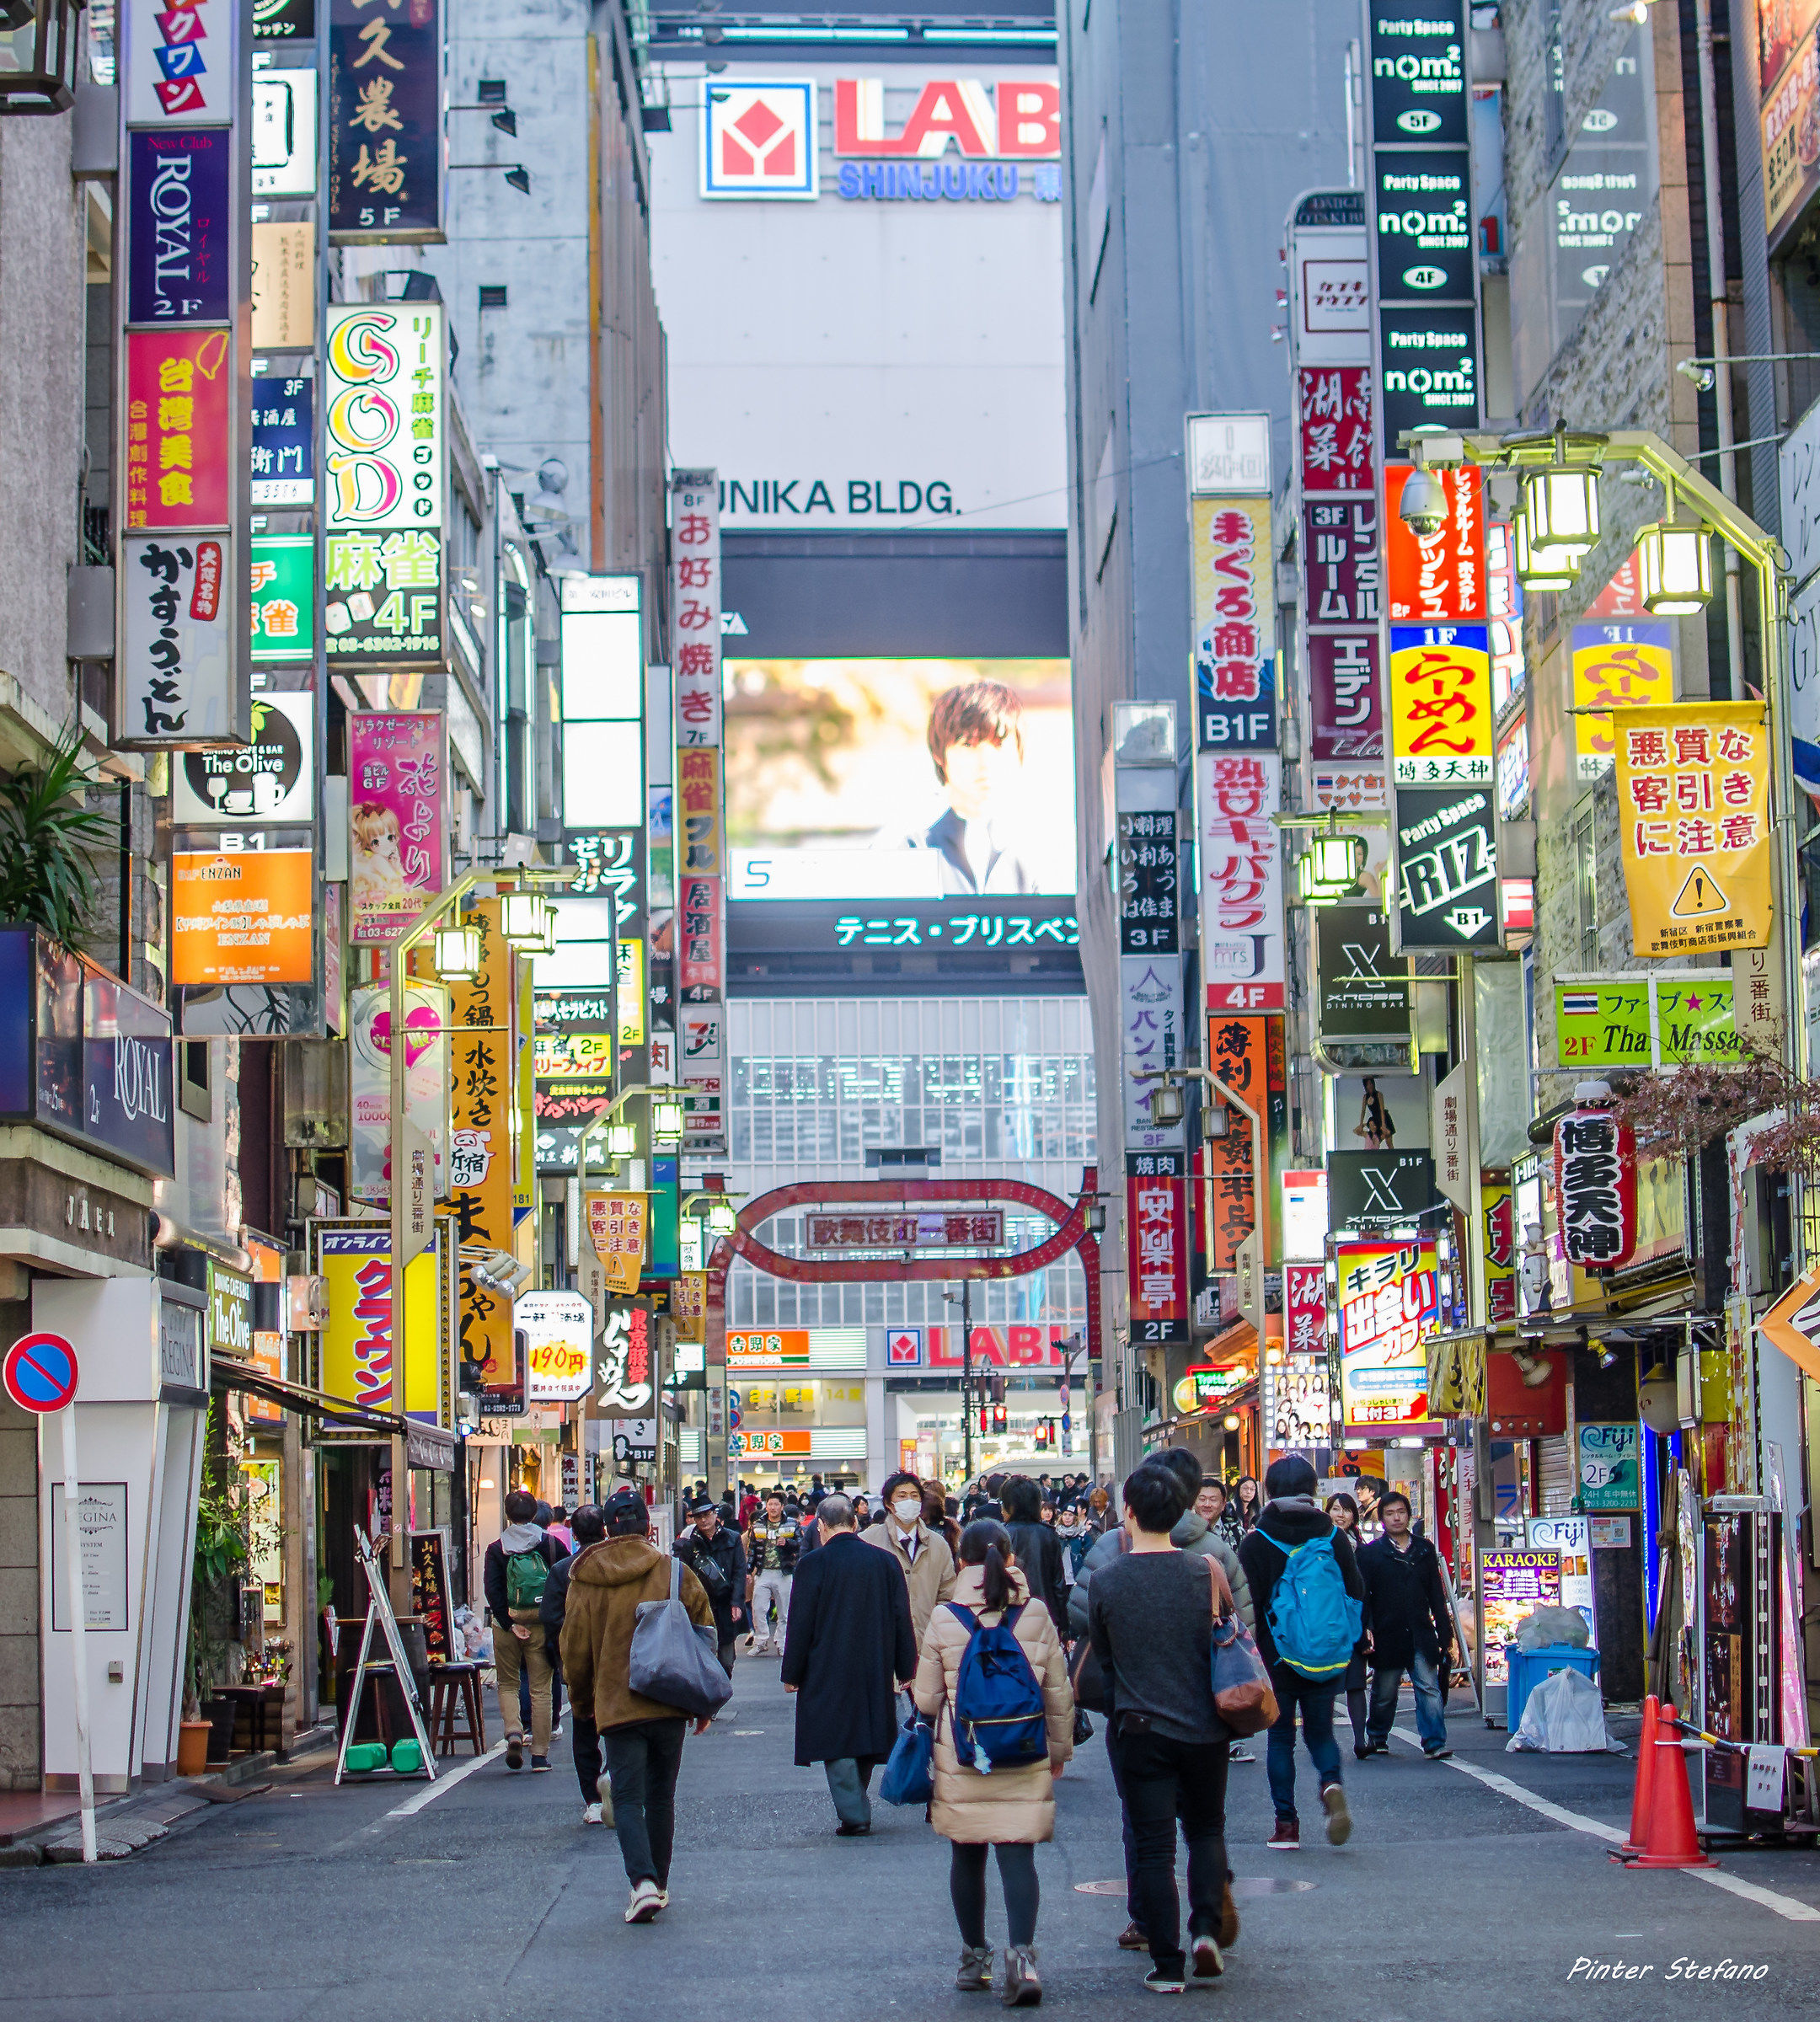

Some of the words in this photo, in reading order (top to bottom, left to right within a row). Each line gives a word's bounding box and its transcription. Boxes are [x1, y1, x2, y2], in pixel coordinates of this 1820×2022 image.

[1378, 19, 1414, 37] Party
[1415, 19, 1455, 37] Space
[167, 0, 195, 111] クワン
[349, 0, 409, 195] 久農場
[1408, 113, 1431, 129] 5F
[147, 136, 175, 150] New
[179, 136, 212, 150] Club
[838, 163, 1019, 201] SHINJUKU
[1383, 174, 1419, 192] Party
[1420, 174, 1461, 191] Space
[149, 154, 192, 296] ROYAL
[359, 206, 403, 227] 5F
[1414, 270, 1437, 286] 4F
[1389, 332, 1426, 350] Party
[1427, 331, 1467, 348] Space
[283, 379, 304, 397] 3F
[683, 494, 705, 507] 8F
[848, 479, 962, 516] BLDG.
[1314, 506, 1345, 526] 3F
[325, 530, 442, 591] 麻雀
[372, 591, 437, 636] 4F
[678, 512, 714, 725] お好み焼き
[1391, 602, 1410, 618] 2F
[140, 543, 194, 736] かすうどん
[1424, 626, 1458, 646] 1F
[1334, 638, 1372, 726] エデン
[1405, 652, 1478, 755] らーめん
[686, 730, 709, 745] 7F
[1205, 713, 1270, 742] B1F
[1627, 727, 1753, 769] 悪質な
[201, 755, 233, 773] The
[235, 754, 285, 773] Olive
[1397, 758, 1491, 783] 博多天神
[1630, 772, 1755, 812] 客引き
[1400, 812, 1442, 848] Party
[1437, 793, 1487, 829] Space
[219, 832, 266, 851] B1
[1635, 814, 1758, 859] に注意
[201, 867, 242, 880] ENZAN
[685, 882, 714, 963] 居酒屋
[1457, 912, 1480, 927] B1
[217, 933, 271, 945] ENZAN
[1129, 928, 1170, 946] 3F
[688, 986, 714, 1001] 4F
[1226, 984, 1266, 1008] 4F
[581, 1039, 603, 1055] 2F
[1564, 1036, 1597, 1057] 2F
[113, 1030, 168, 1124] ROYAL
[1443, 1095, 1459, 1183] 劇場通り一番街
[1136, 1156, 1176, 1175] 焼肉
[1399, 1157, 1423, 1167] B1F
[1561, 1117, 1623, 1261] 博多天神
[592, 1201, 643, 1217] 悪質な
[592, 1219, 641, 1235] 客引き
[813, 1216, 998, 1245] 歌舞伎町一番街
[1138, 1187, 1176, 1310] 安楽亭
[1346, 1243, 1421, 1293] キラリ
[1346, 1268, 1433, 1351] 出会い
[214, 1294, 230, 1345] The
[229, 1298, 251, 1351] Olive
[1144, 1322, 1174, 1340] 2F
[730, 1335, 783, 1353] 吉野家
[1382, 1317, 1441, 1365] カフェ
[531, 1346, 586, 1371] 190円
[1601, 1427, 1635, 1452] Fiji
[1586, 1465, 1609, 1484] 2F
[1553, 1522, 1585, 1548] Fiji
[1483, 1553, 1558, 1568] KARAOKE
